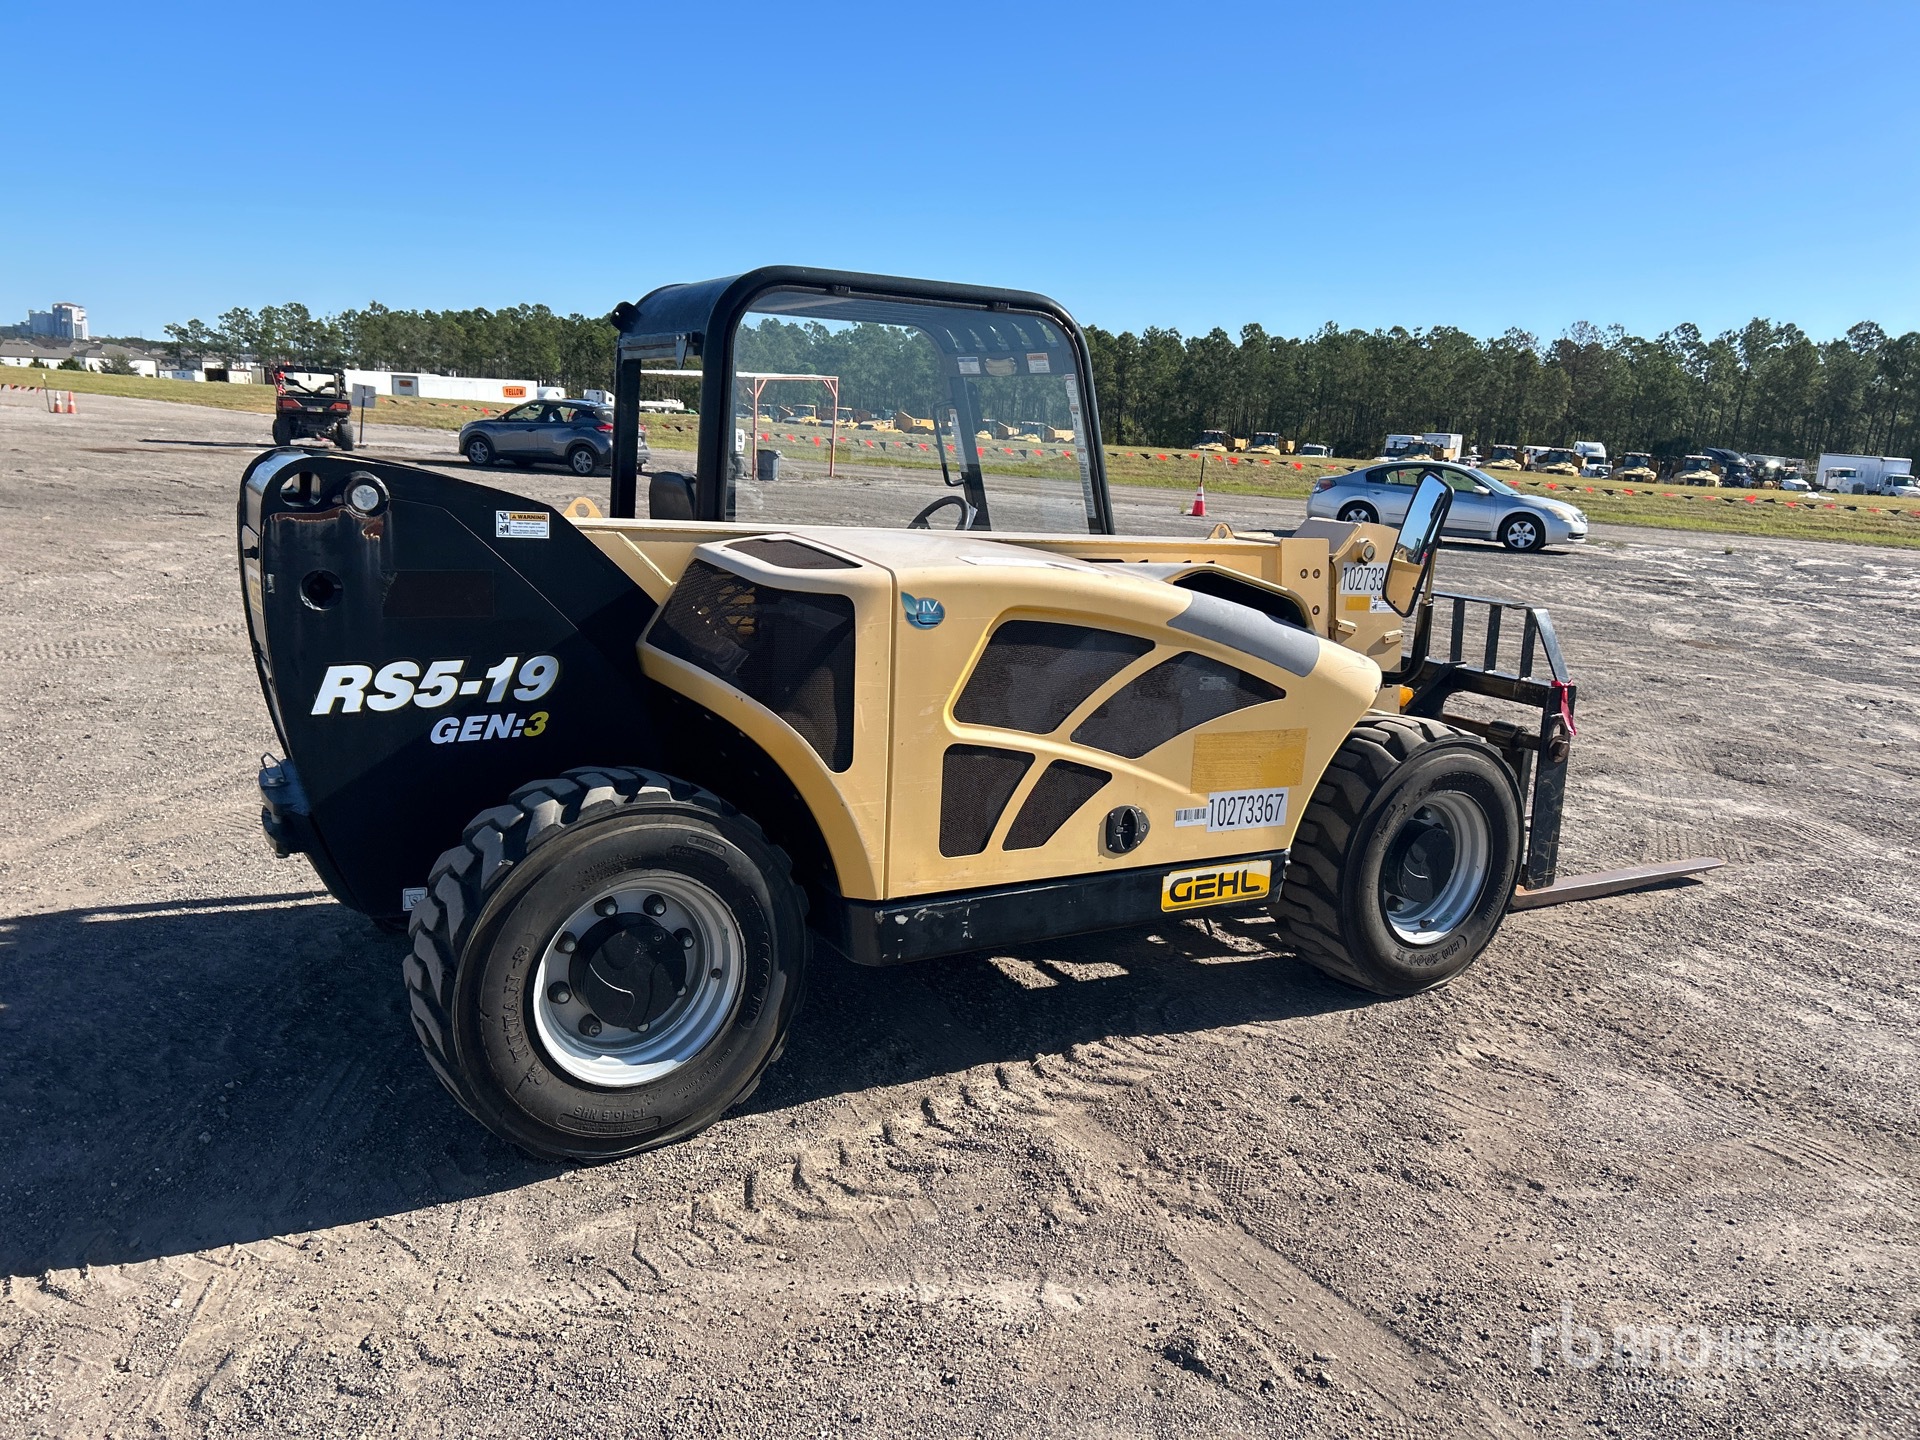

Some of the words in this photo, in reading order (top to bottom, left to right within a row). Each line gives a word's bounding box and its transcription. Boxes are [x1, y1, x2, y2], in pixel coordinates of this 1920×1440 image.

[505, 388, 524, 396] YELLOW
[1342, 566, 1384, 591] 102733
[922, 600, 939, 612] IV
[311, 655, 559, 715] RS5-19
[1209, 793, 1284, 828] 10273367
[1169, 869, 1260, 902] GEHL
[502, 974, 530, 1063] TITAN
